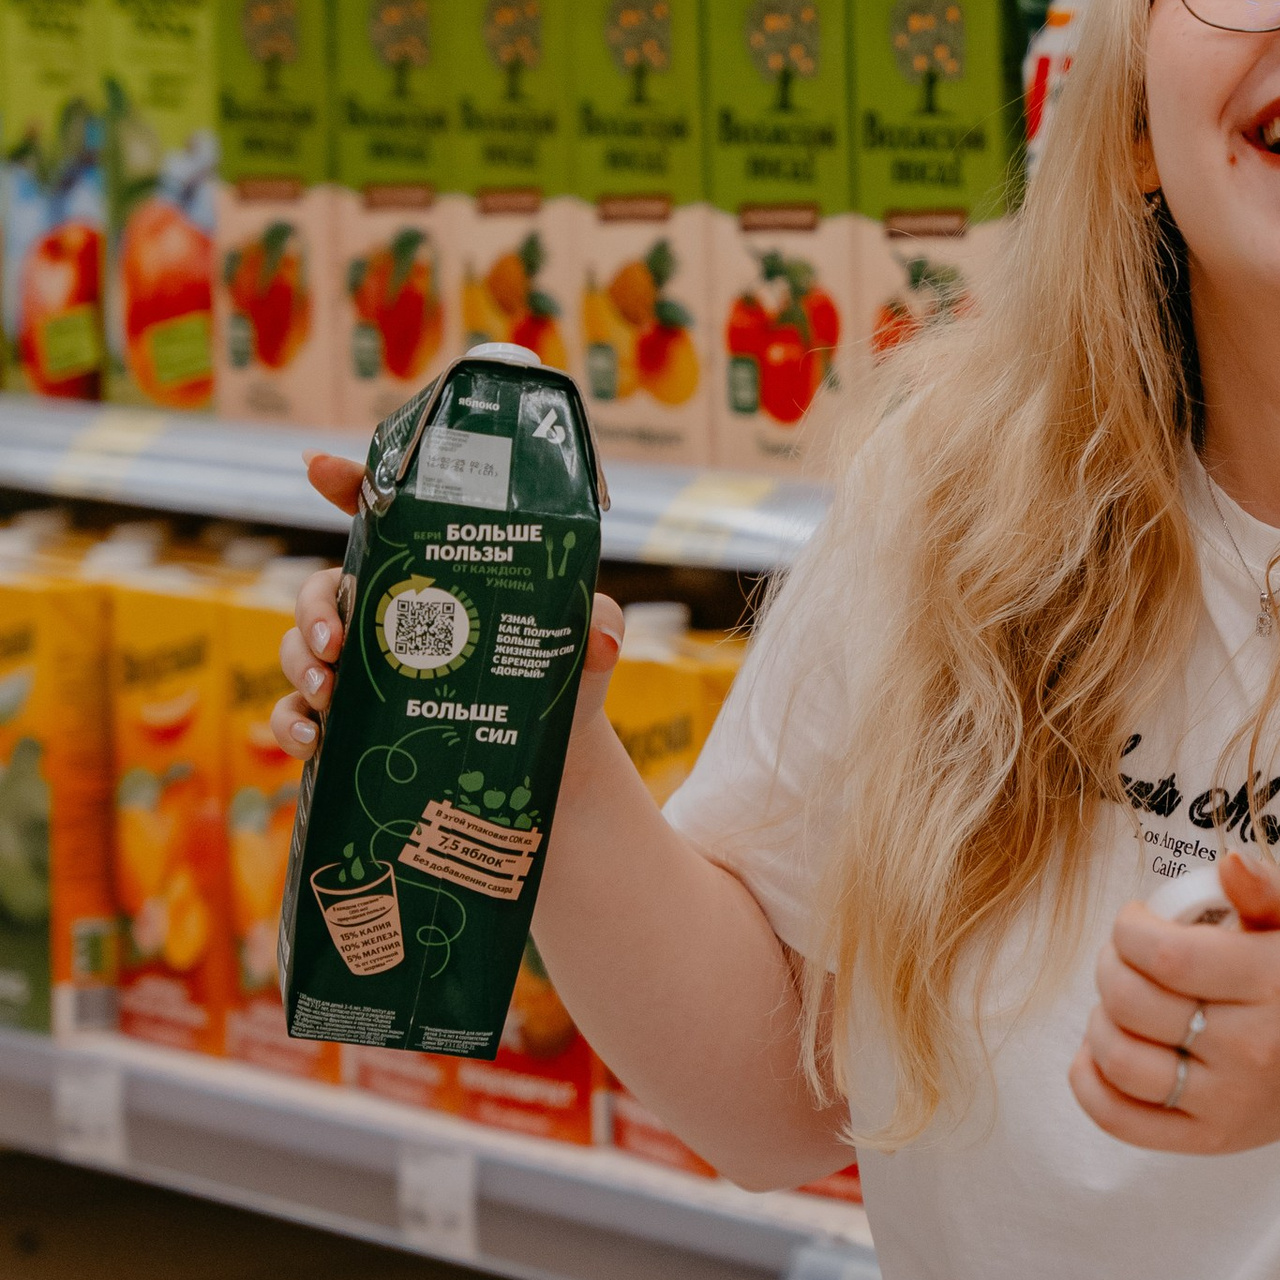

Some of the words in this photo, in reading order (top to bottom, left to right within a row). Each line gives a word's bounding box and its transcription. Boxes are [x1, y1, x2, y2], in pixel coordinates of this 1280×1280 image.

[458, 397, 500, 412] яблоко
[414, 531, 441, 541] БЕРИ
[446, 523, 543, 543] БОЛЬШЕ
[425, 544, 514, 563] ПОЛЬЗЫ
[452, 563, 467, 573] ОТ
[470, 564, 532, 577] КАЖДОГО
[486, 577, 535, 593] УЖИНА
[498, 624, 520, 635] КАК
[523, 627, 572, 638] ПОЛУЧИТЬ
[496, 634, 541, 648] БОЛЬШЕ
[494, 644, 559, 658] ЖИЗНЕННЫХ
[559, 644, 575, 655] СИЛ
[492, 655, 499, 664] С
[500, 655, 550, 669] БРЕНДОМ
[490, 665, 545, 679] «ДОБРЫЙ»
[406, 699, 509, 723] БОЛЬШЕ
[475, 726, 518, 746] СИЛ
[442, 812, 466, 827] этой
[466, 820, 508, 842] упаковке
[508, 834, 524, 845] СОК
[438, 834, 461, 852] 7,5
[1159, 829, 1218, 862] Angeles
[413, 853, 430, 867] Без
[430, 859, 486, 889] добавления
[487, 881, 513, 895] сахара
[340, 931, 359, 942] 15%
[359, 920, 392, 936] КАЛИЯ
[340, 941, 361, 953] 10%
[361, 930, 400, 948] ЖЕЛЕЗА
[346, 952, 362, 964] 5%
[362, 940, 401, 959] МАГНИЯ
